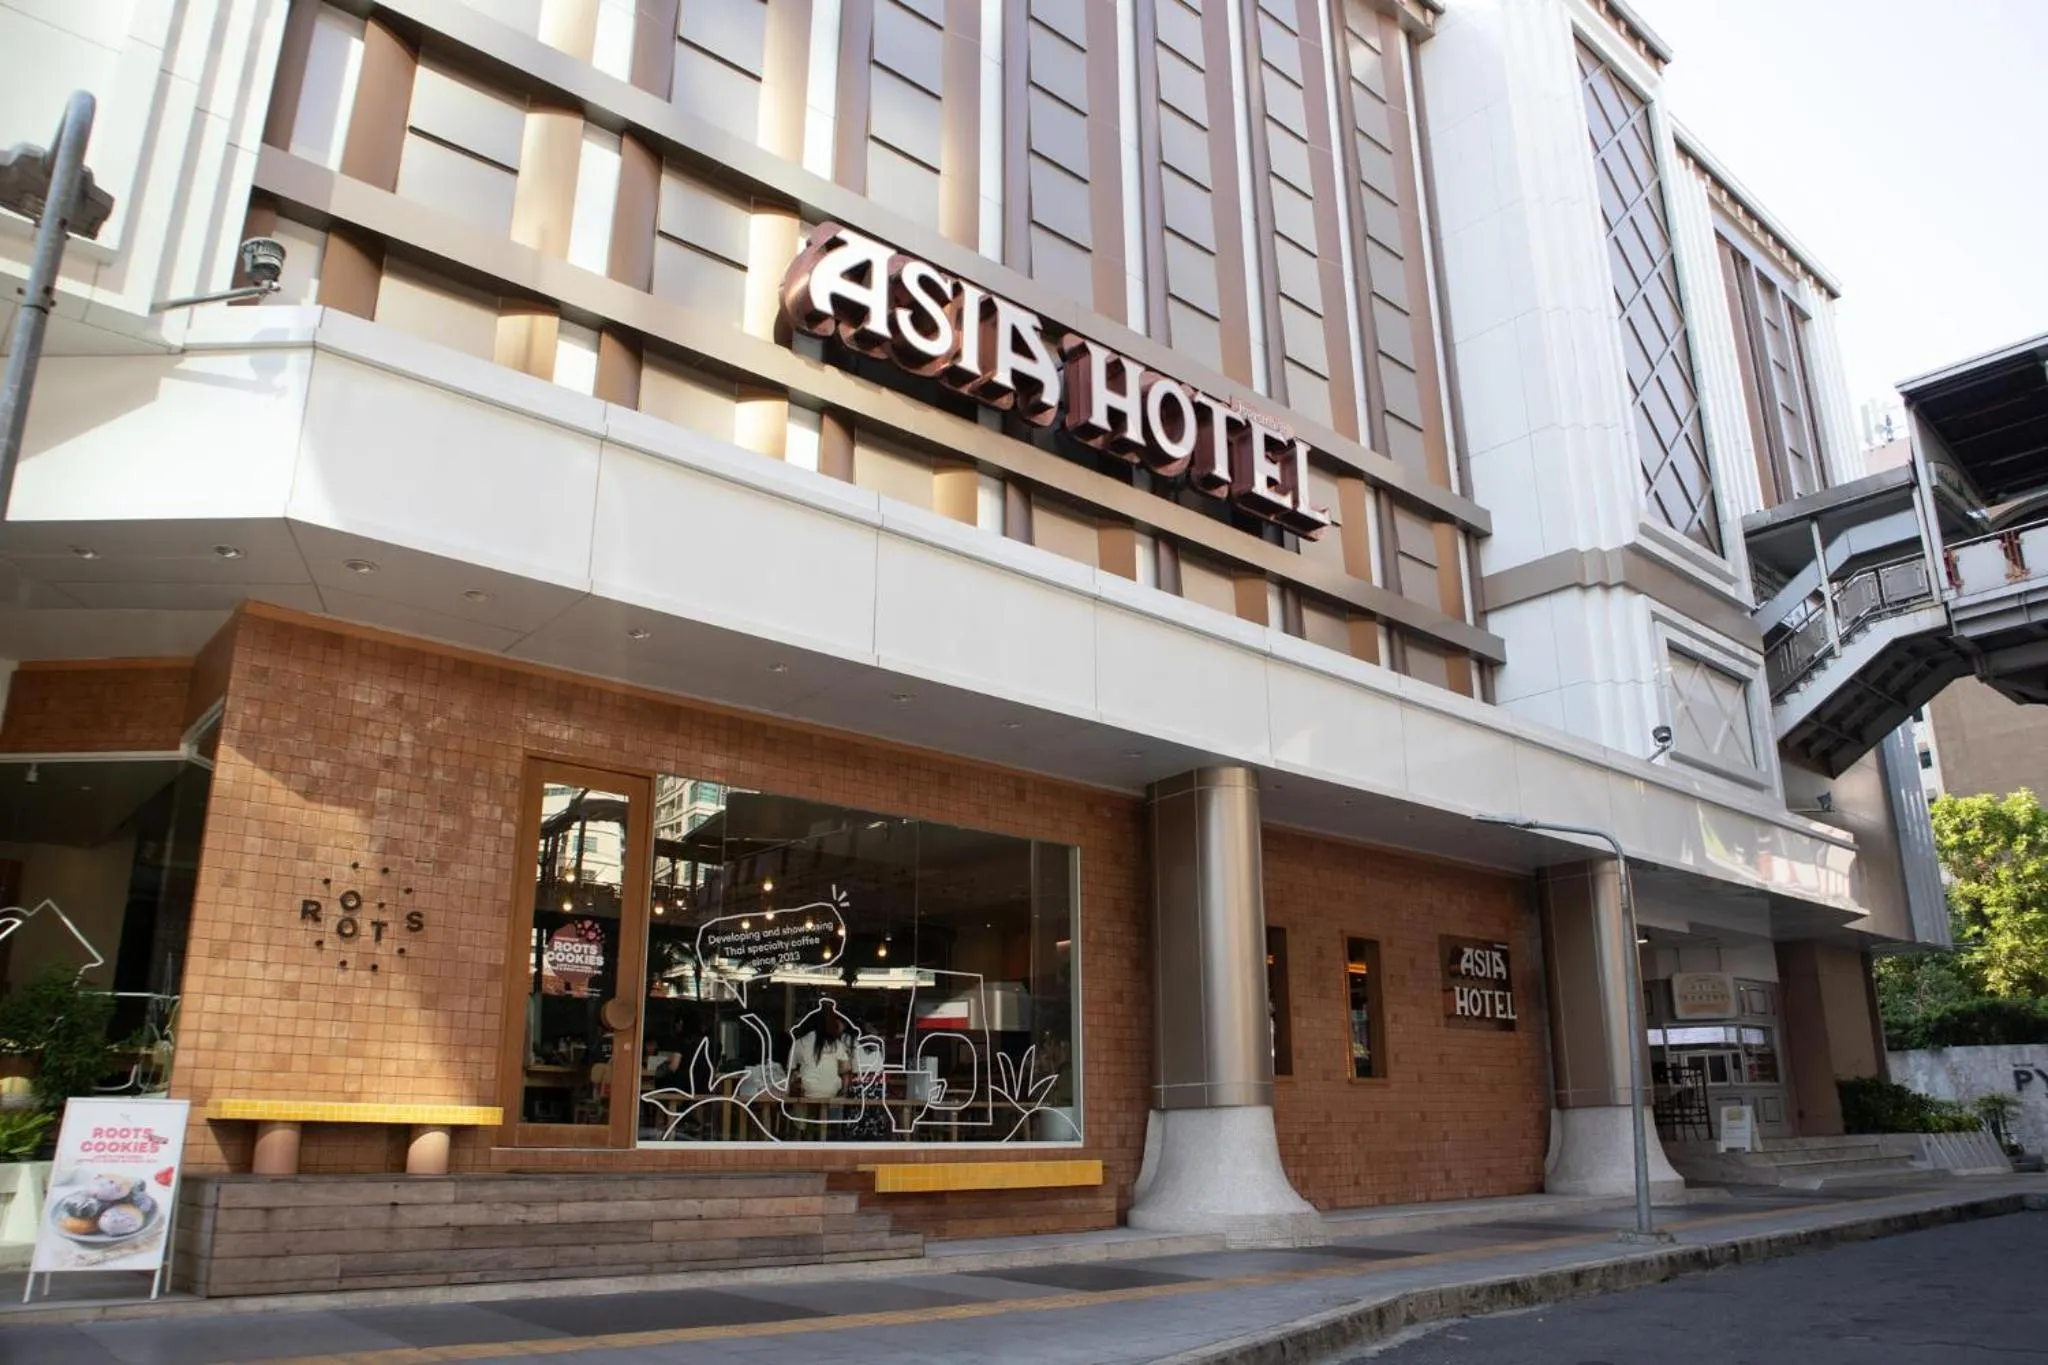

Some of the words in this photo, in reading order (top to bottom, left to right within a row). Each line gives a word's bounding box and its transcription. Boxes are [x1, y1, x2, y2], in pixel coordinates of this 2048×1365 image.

[806, 228, 1062, 406] ASIA
[1082, 339, 1332, 525] HOTEL
[708, 930, 760, 945] Developing
[762, 927, 781, 938] and
[782, 921, 834, 936] showasing
[553, 941, 598, 955] ROOTS
[725, 945, 745, 956] Thai
[748, 939, 790, 954] specialty
[791, 936, 820, 947] coffee
[547, 951, 604, 966] COOKIES
[751, 956, 776, 967] since
[778, 951, 801, 962] 2013
[1461, 947, 1507, 980] ASIA
[1454, 986, 1518, 1019] HOTEL
[92, 1127, 153, 1138] ROOTS
[80, 1141, 159, 1153] COOKIES
